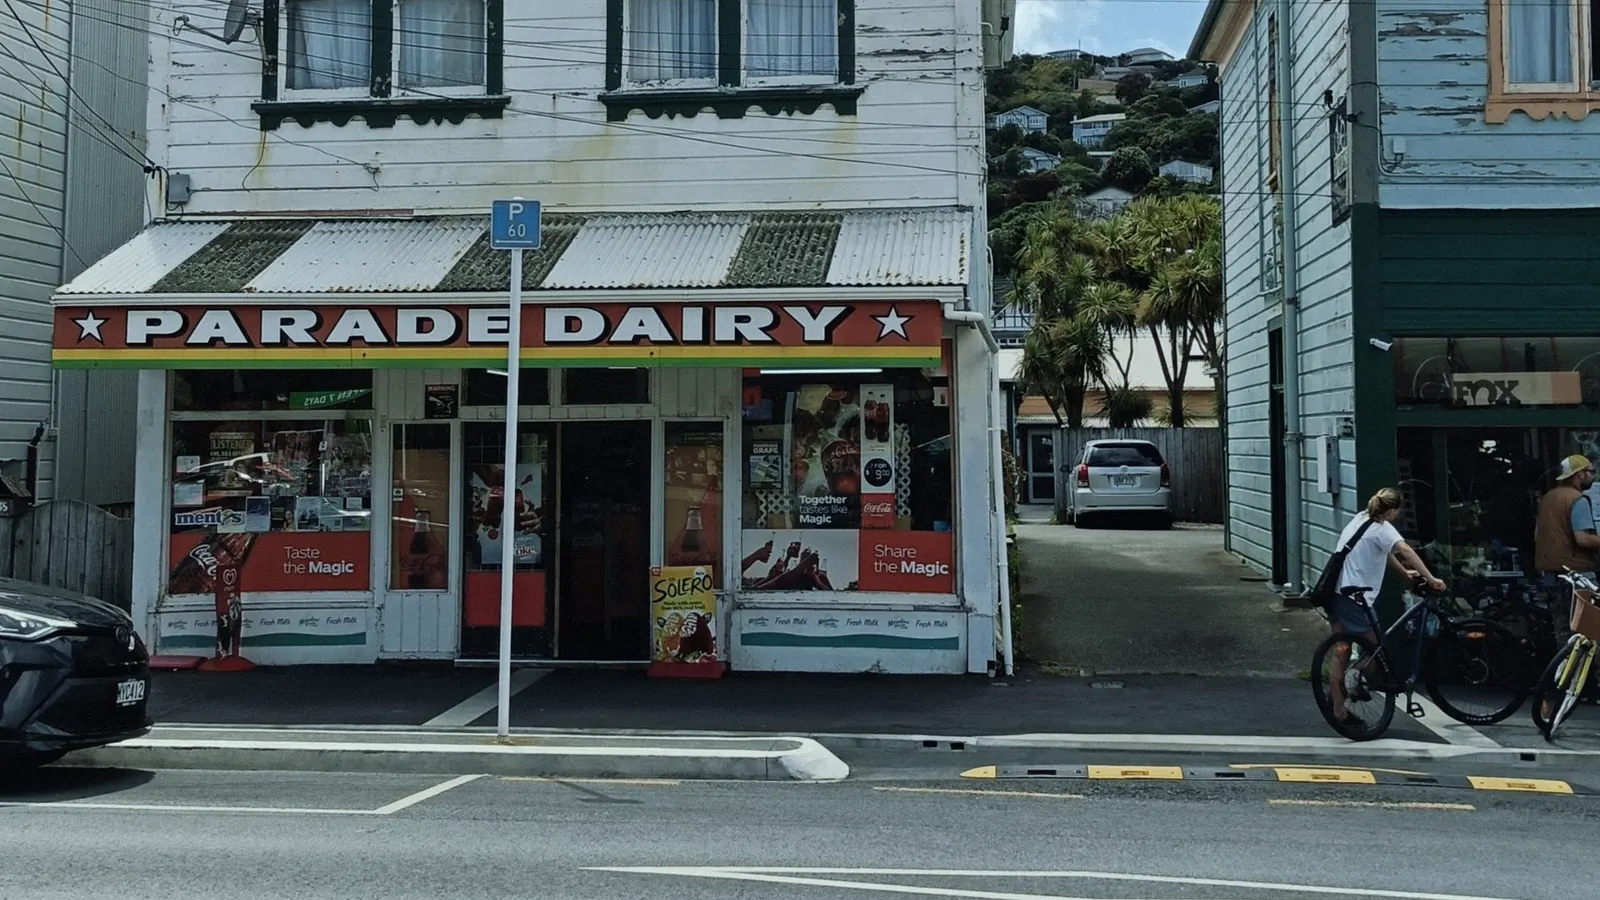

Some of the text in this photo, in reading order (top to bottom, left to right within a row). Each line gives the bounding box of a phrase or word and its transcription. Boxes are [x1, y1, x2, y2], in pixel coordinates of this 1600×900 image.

[509, 203, 523, 220] P
[508, 224, 525, 237] 60
[125, 305, 853, 345] PARADE DAIRY
[1453, 379, 1521, 407] FOX
[0, 501, 8, 511] 5
[799, 495, 847, 506] Together
[799, 505, 848, 514] tastes like
[800, 514, 832, 526] Magic
[284, 546, 320, 559] Taste
[874, 544, 917, 559] Share
[284, 561, 354, 576] the Magic
[874, 560, 949, 577] the Magic
[652, 574, 713, 603] SOLERO
